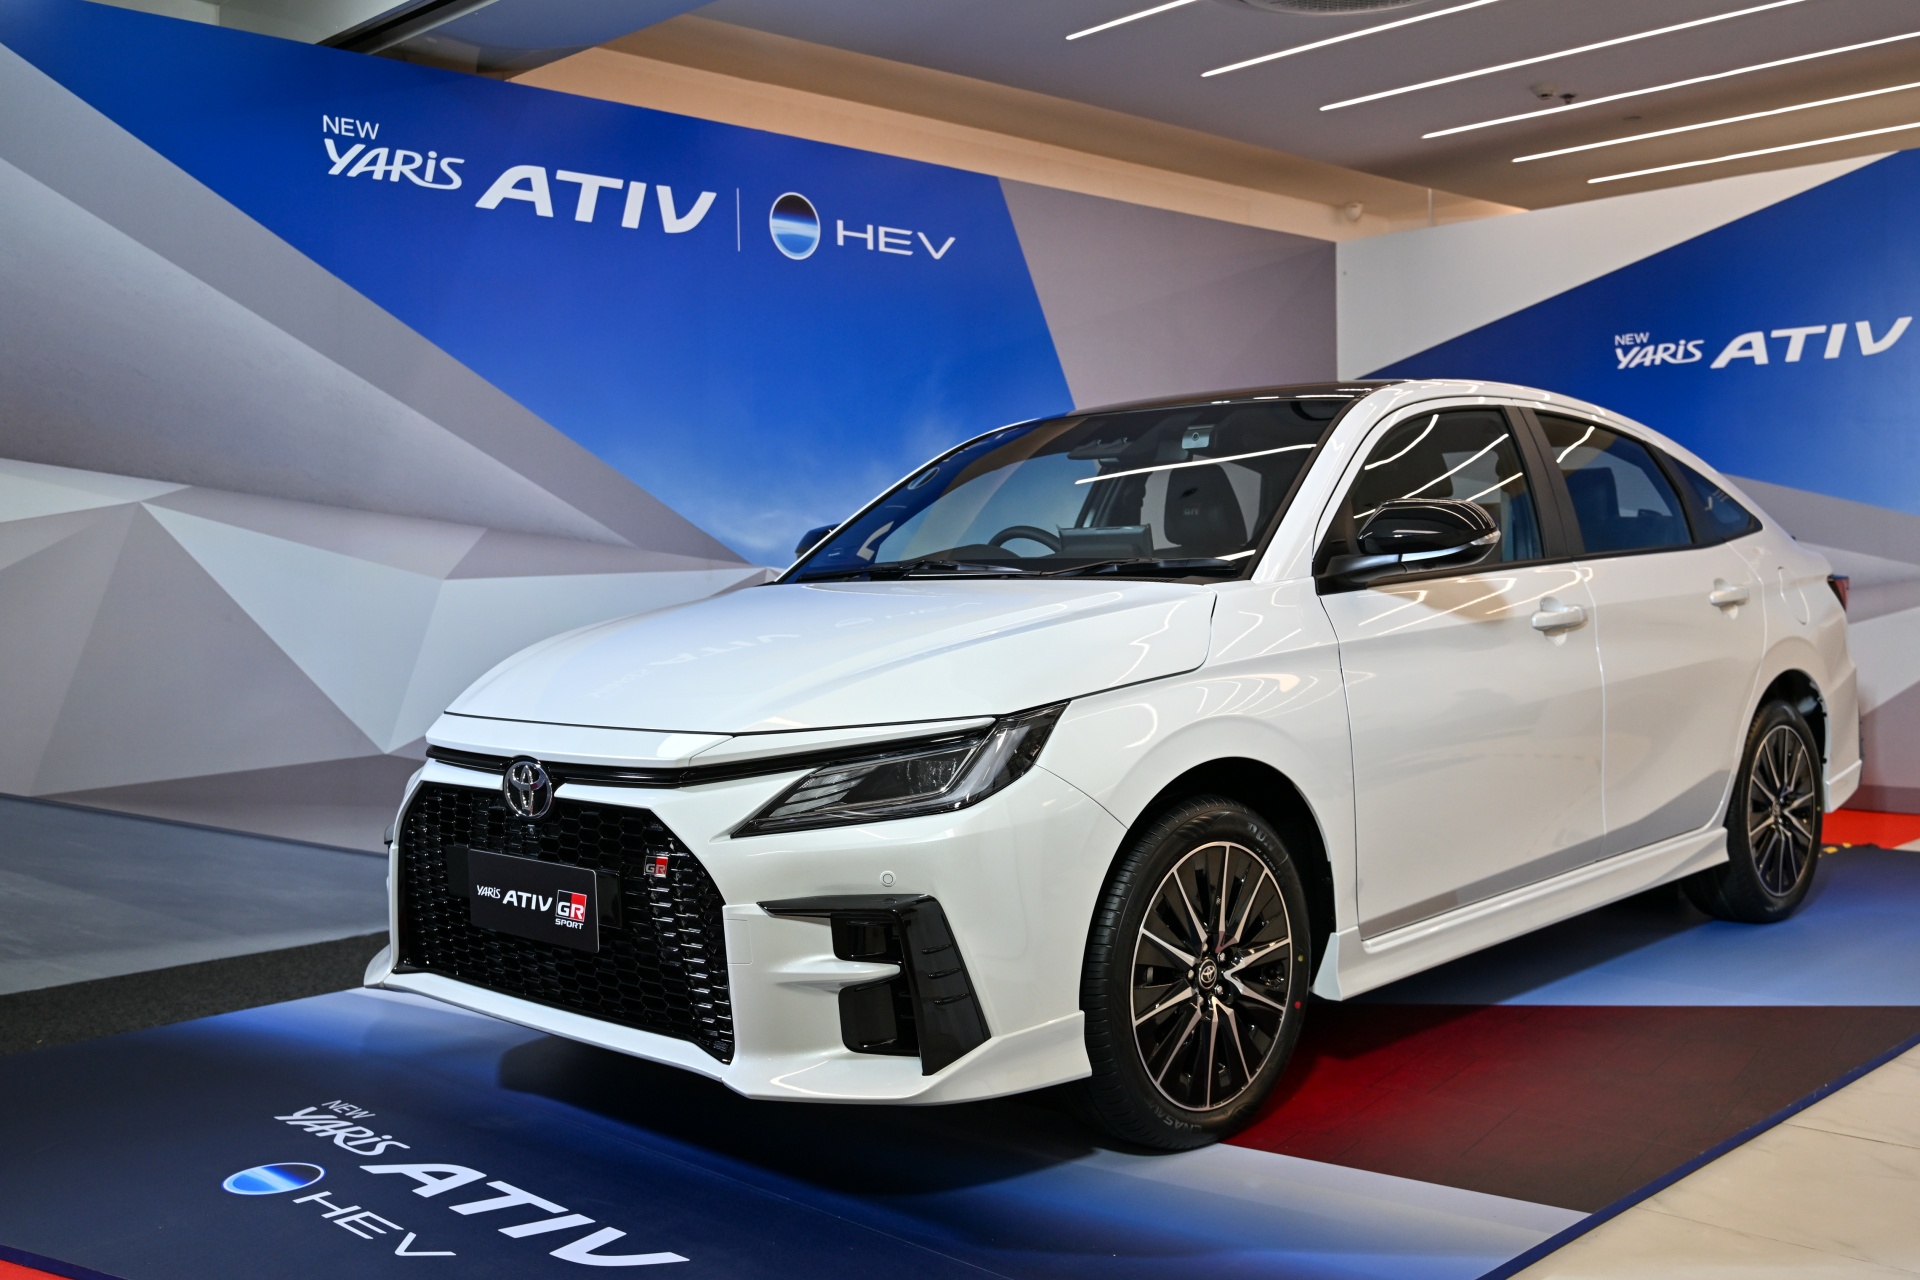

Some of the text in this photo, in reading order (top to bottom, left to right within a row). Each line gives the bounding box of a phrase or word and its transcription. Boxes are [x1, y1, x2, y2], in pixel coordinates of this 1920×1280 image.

[322, 114, 380, 140] NEW
[474, 164, 717, 234] ATIV
[836, 219, 956, 260] HEV
[1614, 332, 1650, 346] NEW
[1710, 315, 1914, 370] ATIV
[502, 889, 553, 912] ATIV
[557, 901, 584, 920] GR
[554, 918, 584, 930] SPORT
[321, 1099, 376, 1119] NEW
[292, 1190, 457, 1257] HEV
[358, 1163, 691, 1267] ATIV
